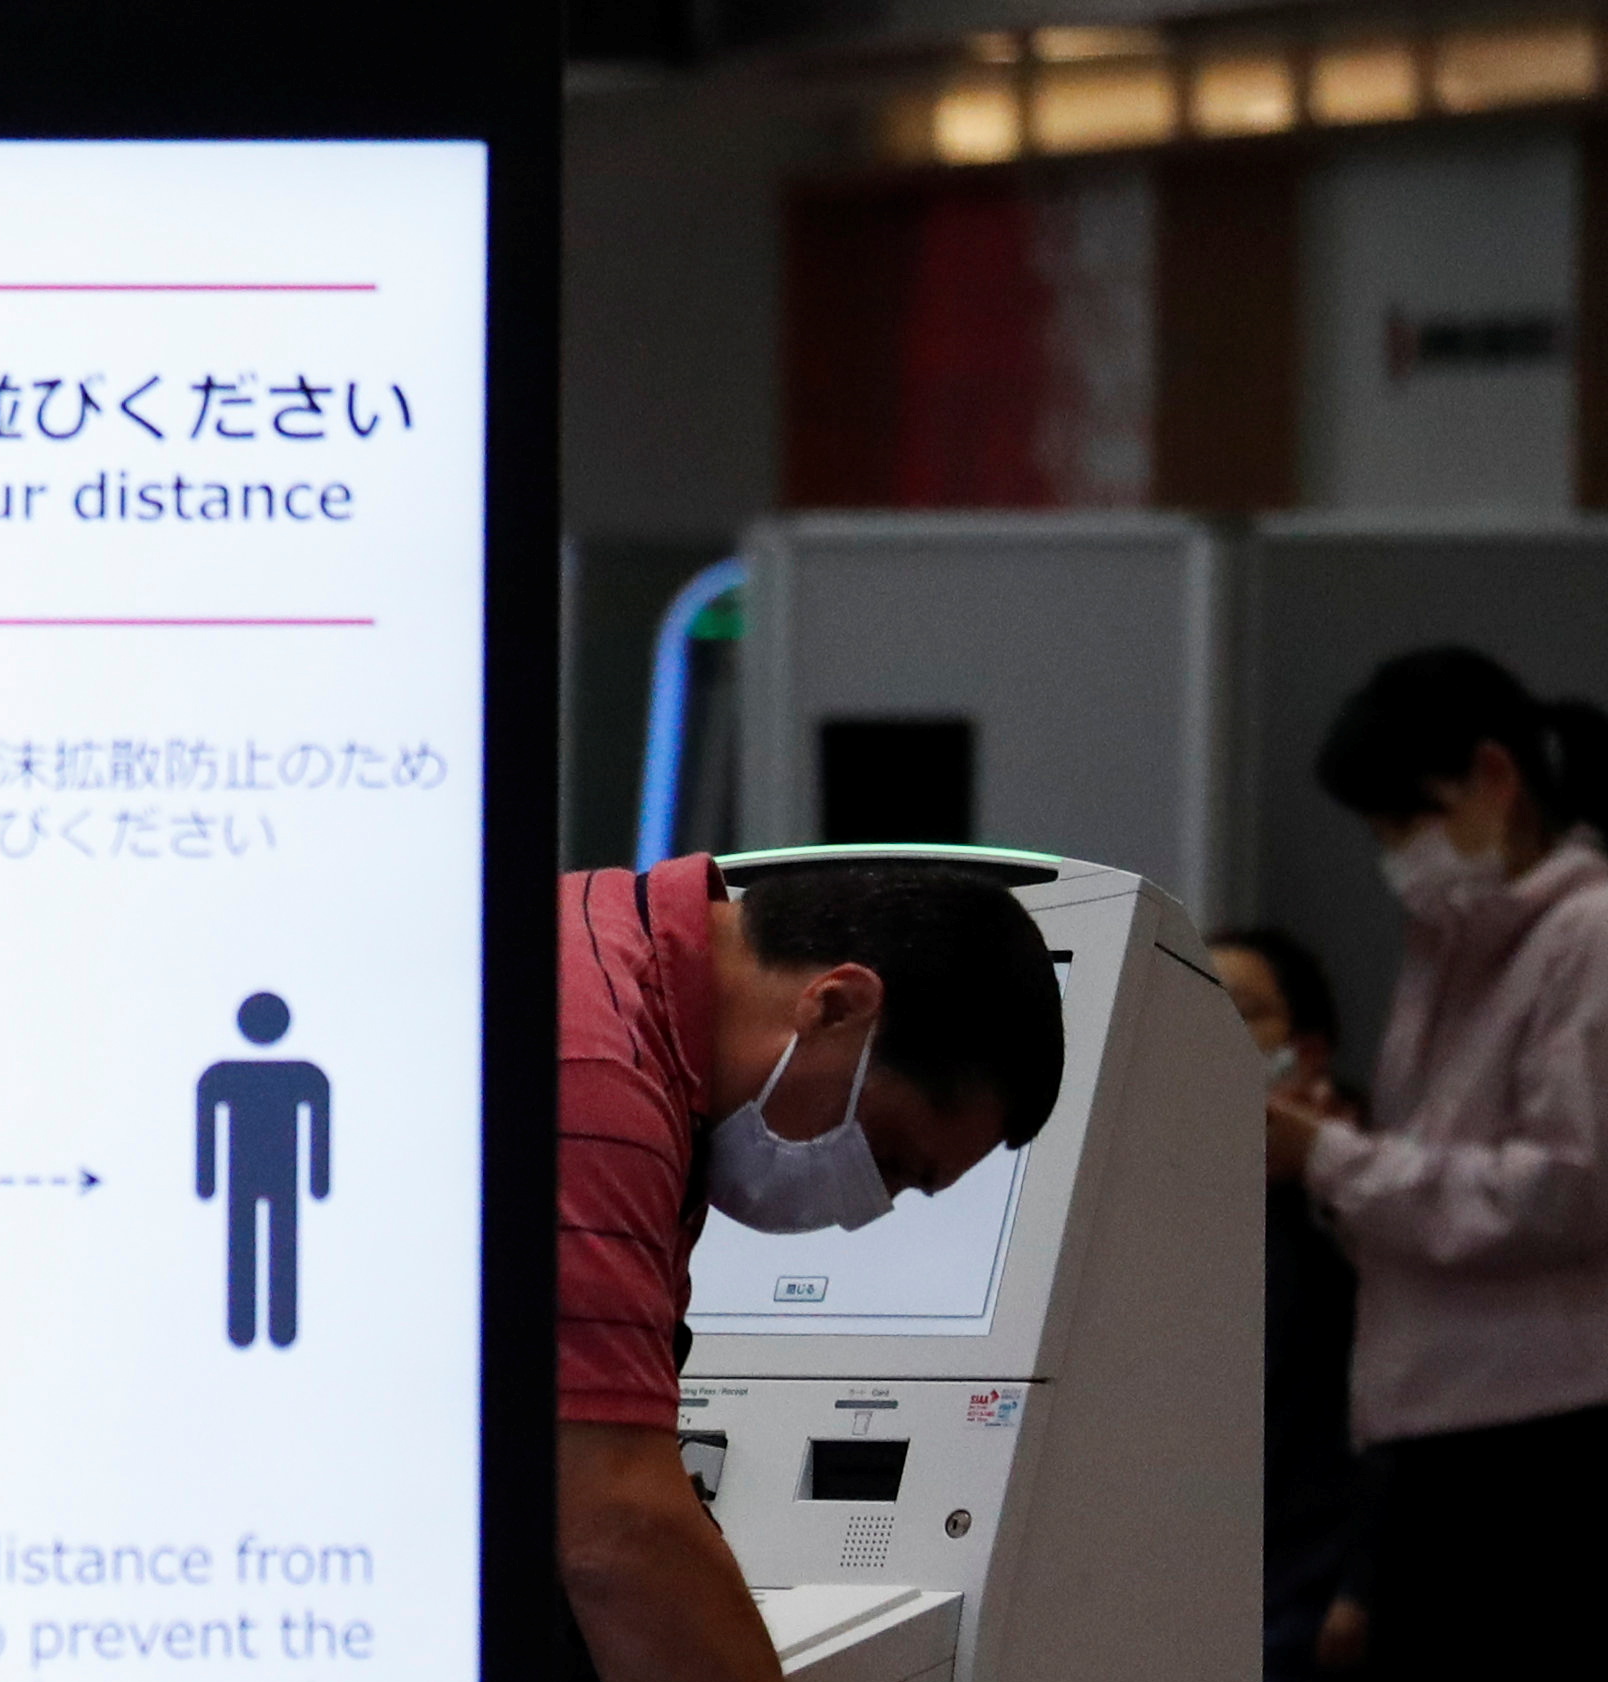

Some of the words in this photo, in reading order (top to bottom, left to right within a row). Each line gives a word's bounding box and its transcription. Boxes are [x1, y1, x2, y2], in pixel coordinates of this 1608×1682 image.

[71, 469, 355, 522] distance
[233, 1532, 377, 1587] from
[28, 1611, 261, 1670] prevent
[276, 1608, 378, 1663] the
